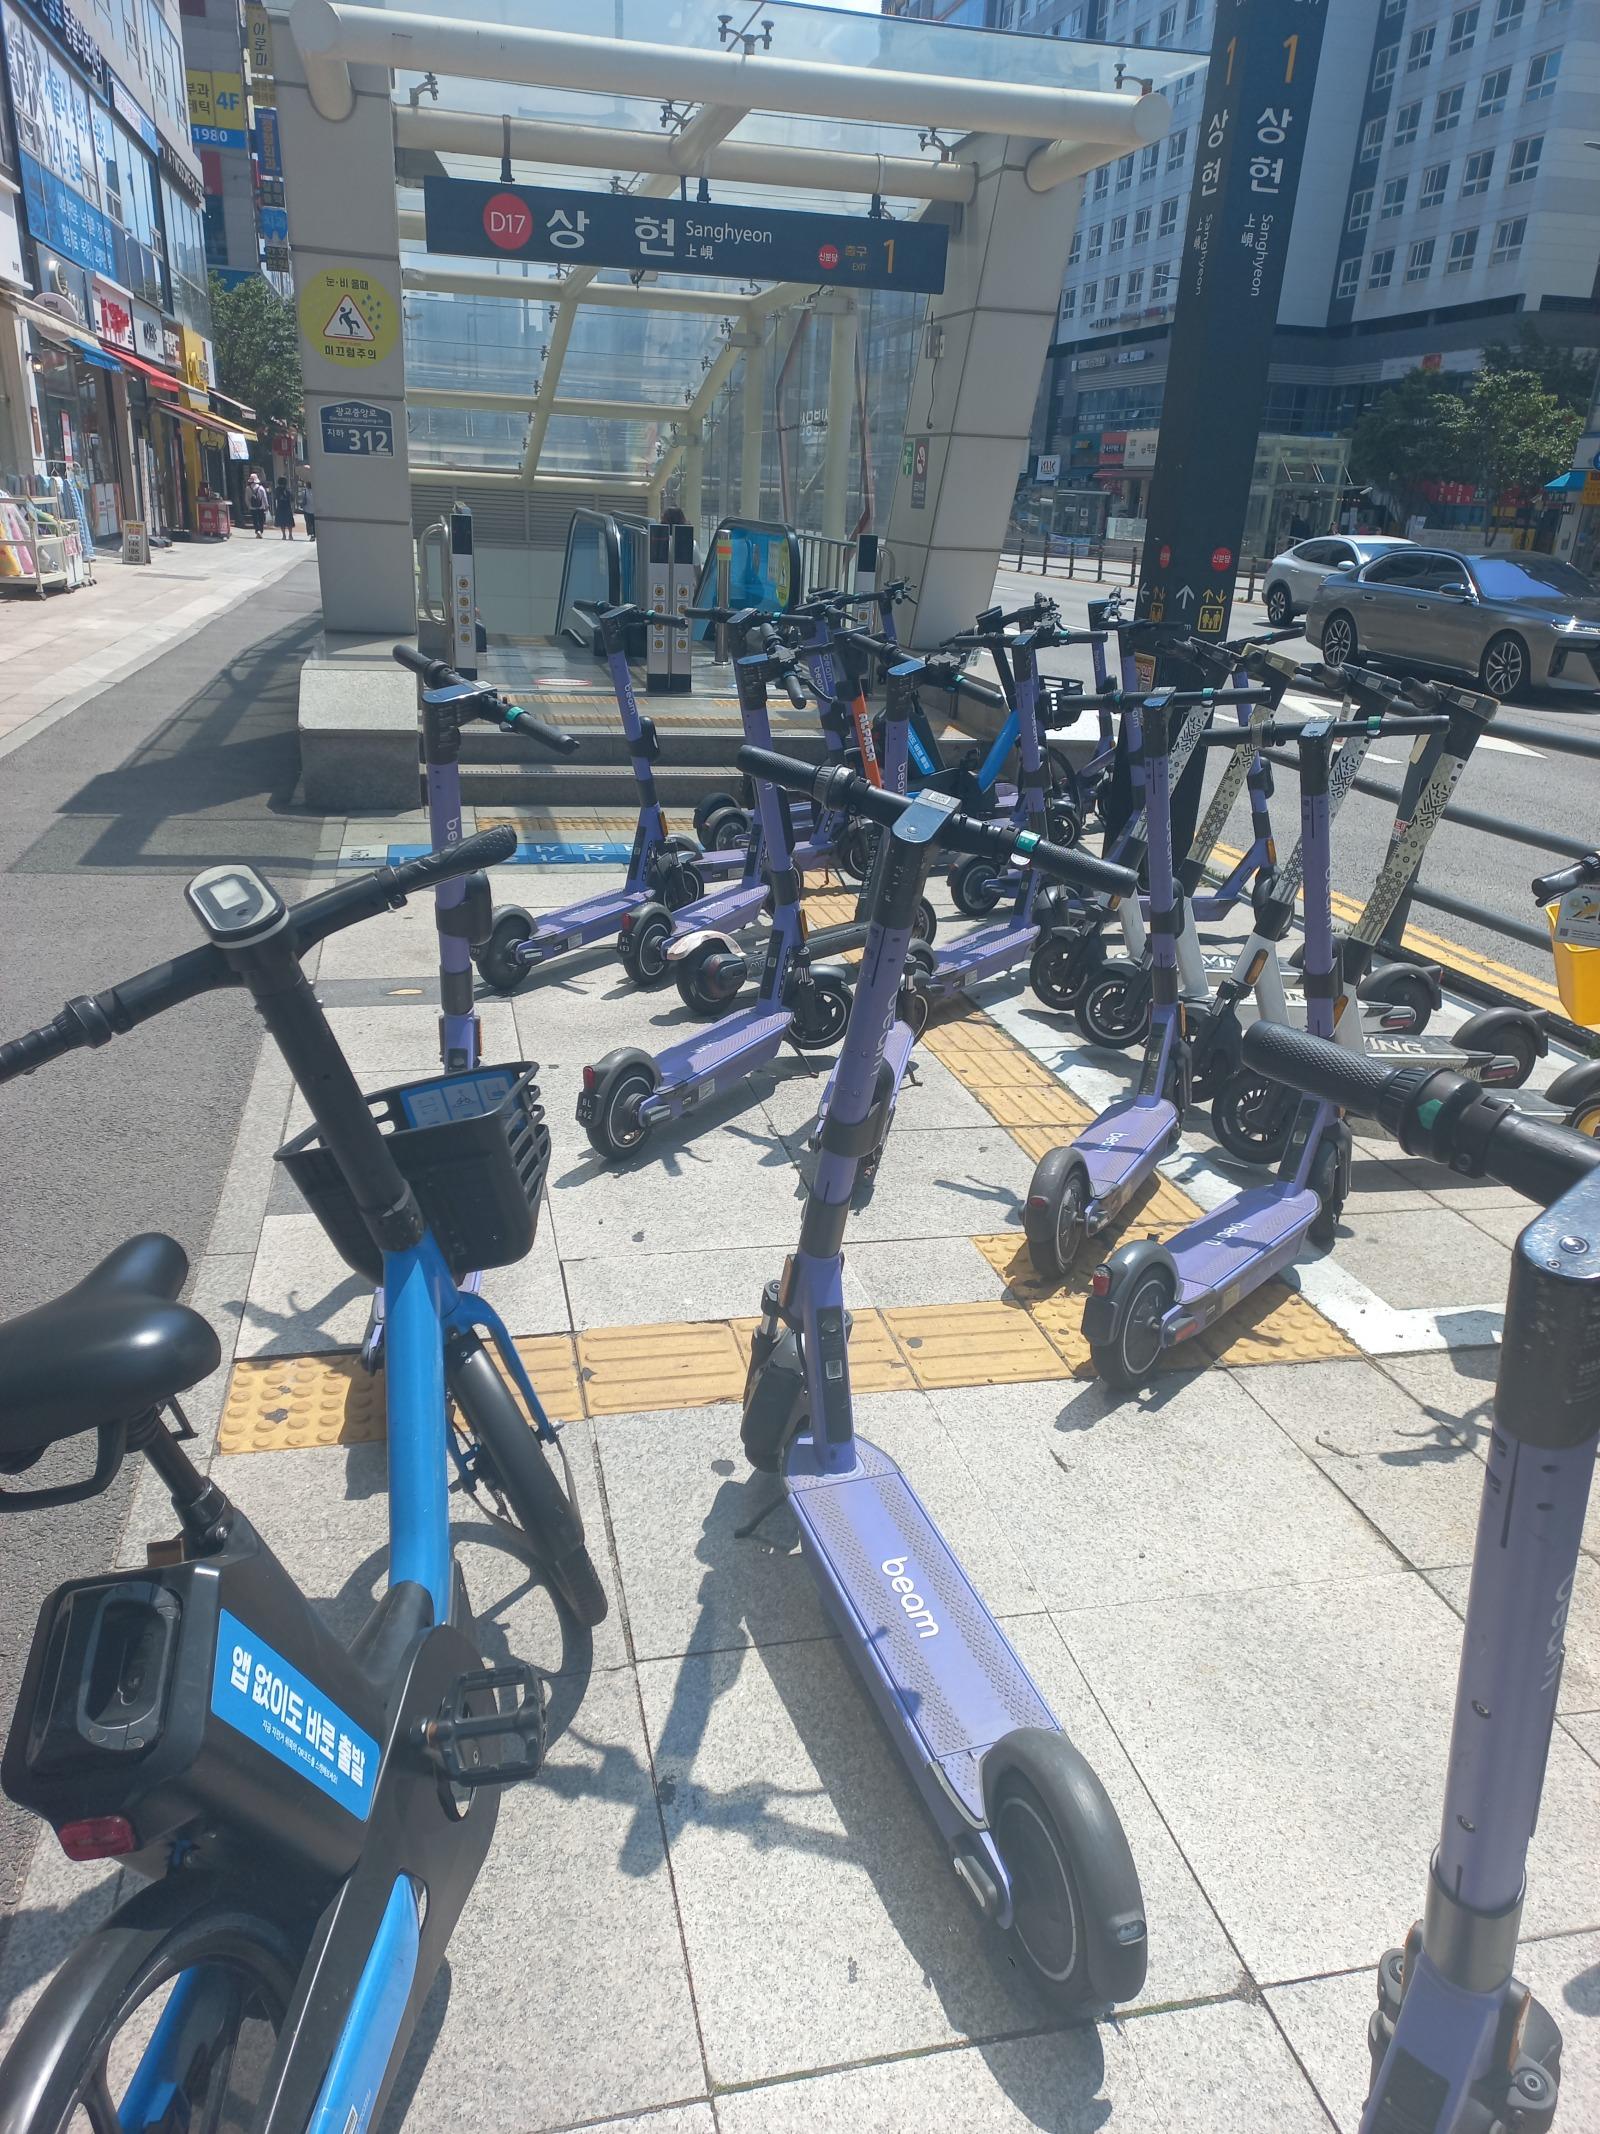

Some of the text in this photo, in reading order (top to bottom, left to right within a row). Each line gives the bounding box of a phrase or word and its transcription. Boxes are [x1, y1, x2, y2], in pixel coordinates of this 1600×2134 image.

[1227, 36, 1237, 86] 1
[1283, 34, 1299, 84] 1
[216, 90, 239, 112] 4F
[193, 127, 228, 142] 1980
[1249, 107, 1293, 194] 상현
[1201, 109, 1229, 196] 상현
[490, 211, 526, 235] D17
[685, 219, 773, 245] Sanghyeon
[883, 239, 896, 274] 1
[1251, 214, 1274, 297] Sanghyeon
[324, 345, 377, 360] 미끄럼주의
[327, 428, 389, 452] 지하 312
[624, 683, 637, 716] beam
[881, 1556, 940, 1639] beam
[230, 1645, 366, 1788] 앱 없이도 바로 출발
